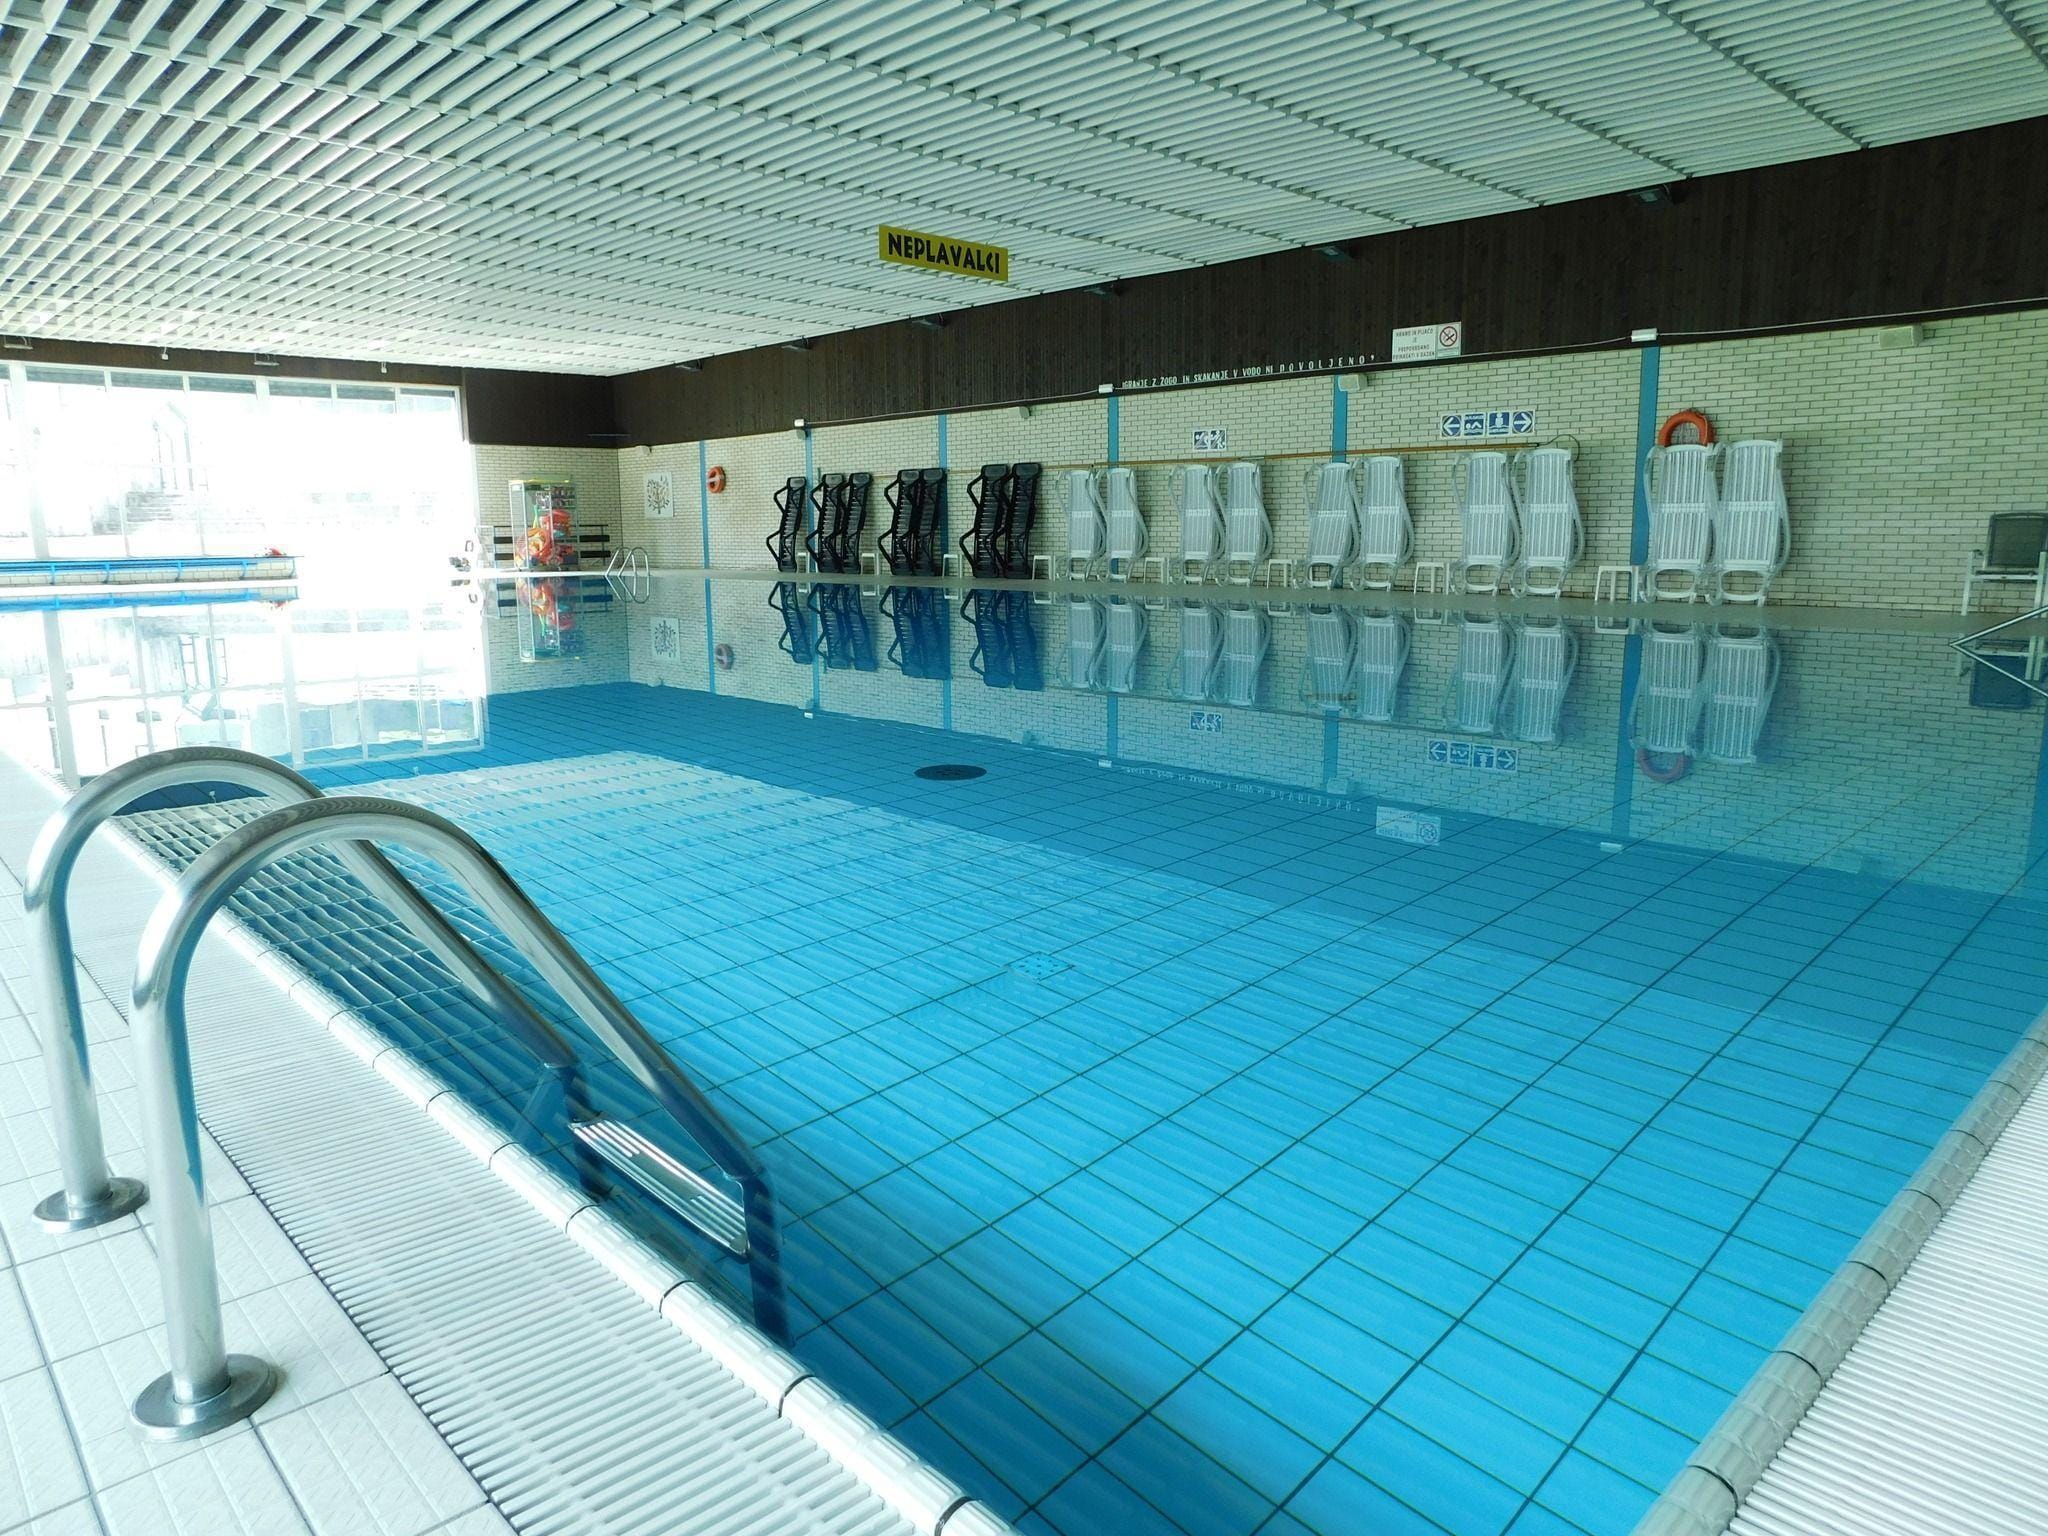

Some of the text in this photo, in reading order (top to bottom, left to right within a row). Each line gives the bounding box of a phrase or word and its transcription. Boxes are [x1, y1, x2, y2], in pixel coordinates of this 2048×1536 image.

[888, 232, 1000, 274] NEPLAVALCI
[1194, 370, 1229, 382] SKAKANJE
[1233, 369, 1238, 378] V
[1242, 366, 1261, 376] VODO
[1265, 365, 1273, 374] NI
